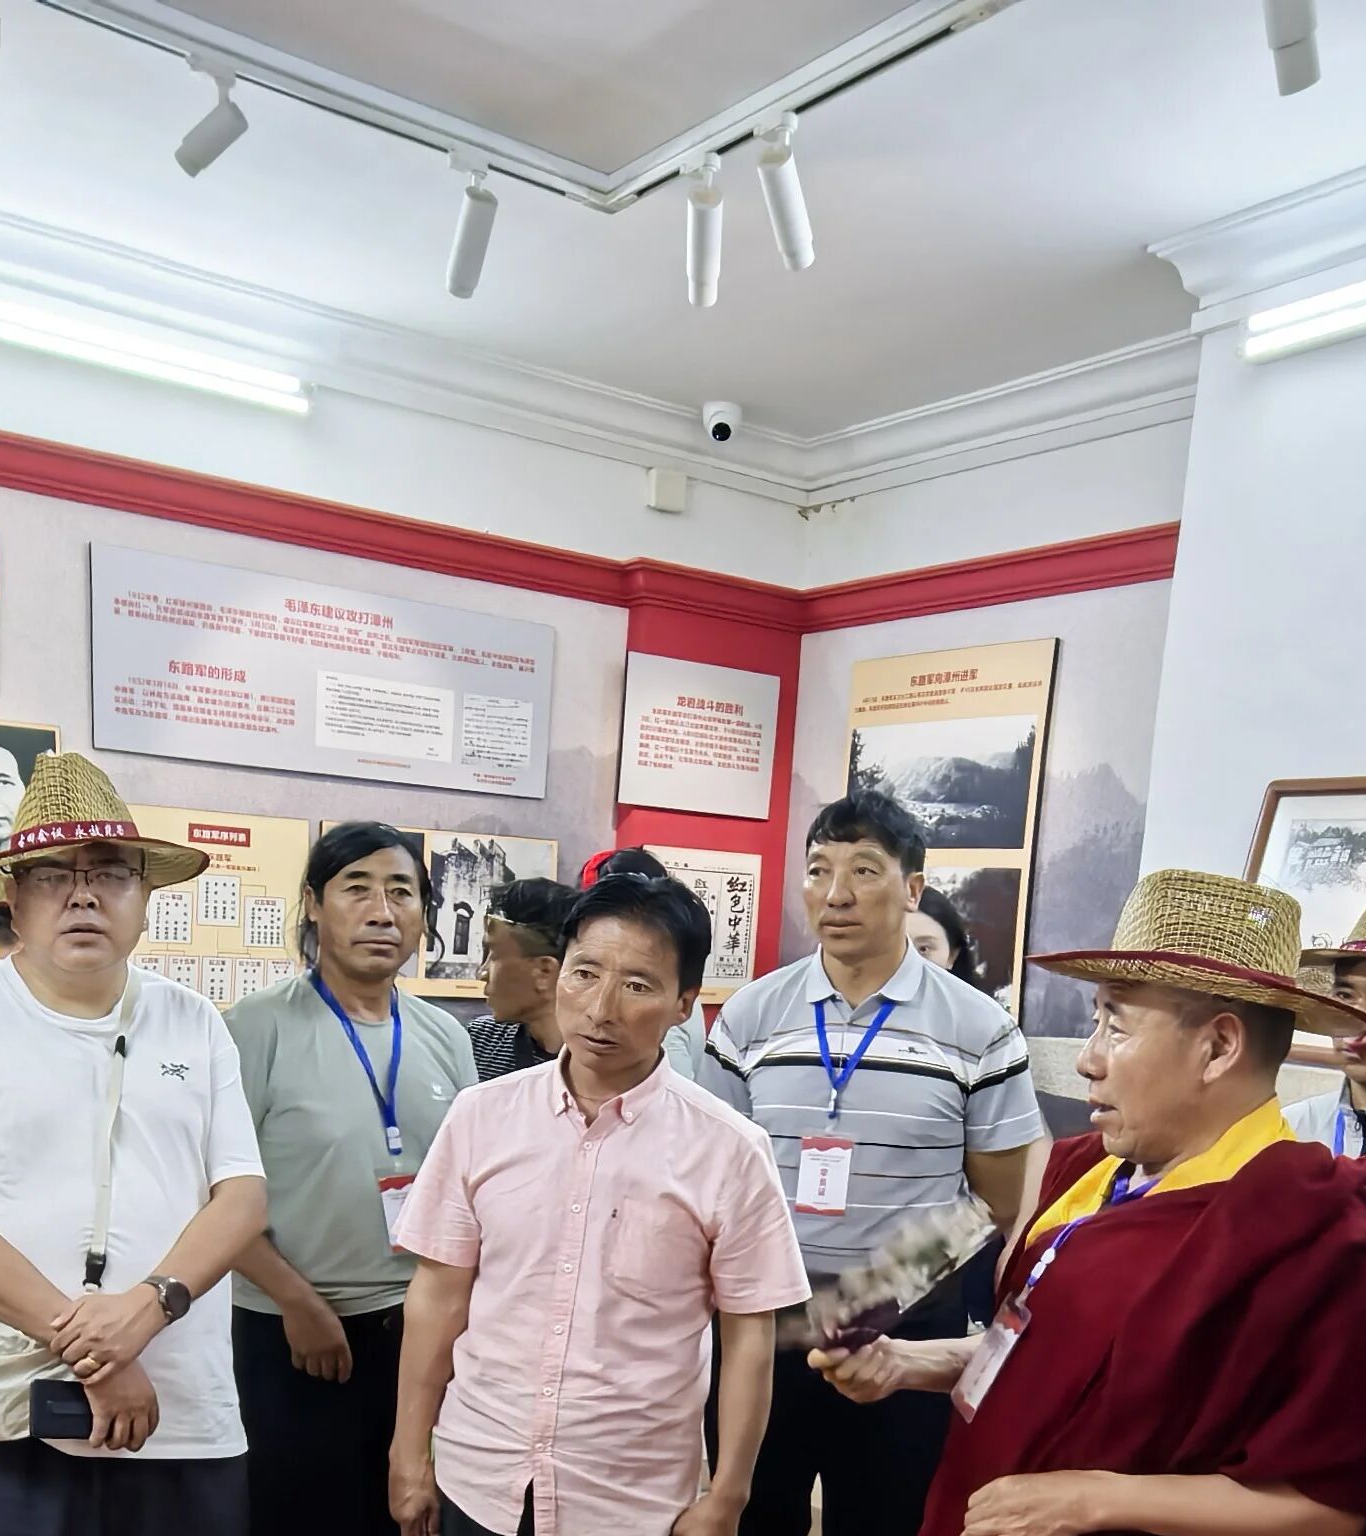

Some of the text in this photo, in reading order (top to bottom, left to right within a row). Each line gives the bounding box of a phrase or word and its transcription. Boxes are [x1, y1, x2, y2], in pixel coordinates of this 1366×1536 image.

[168, 659, 247, 684] 东路军的形成
[677, 696, 744, 717] 龙岩战斗的胜利
